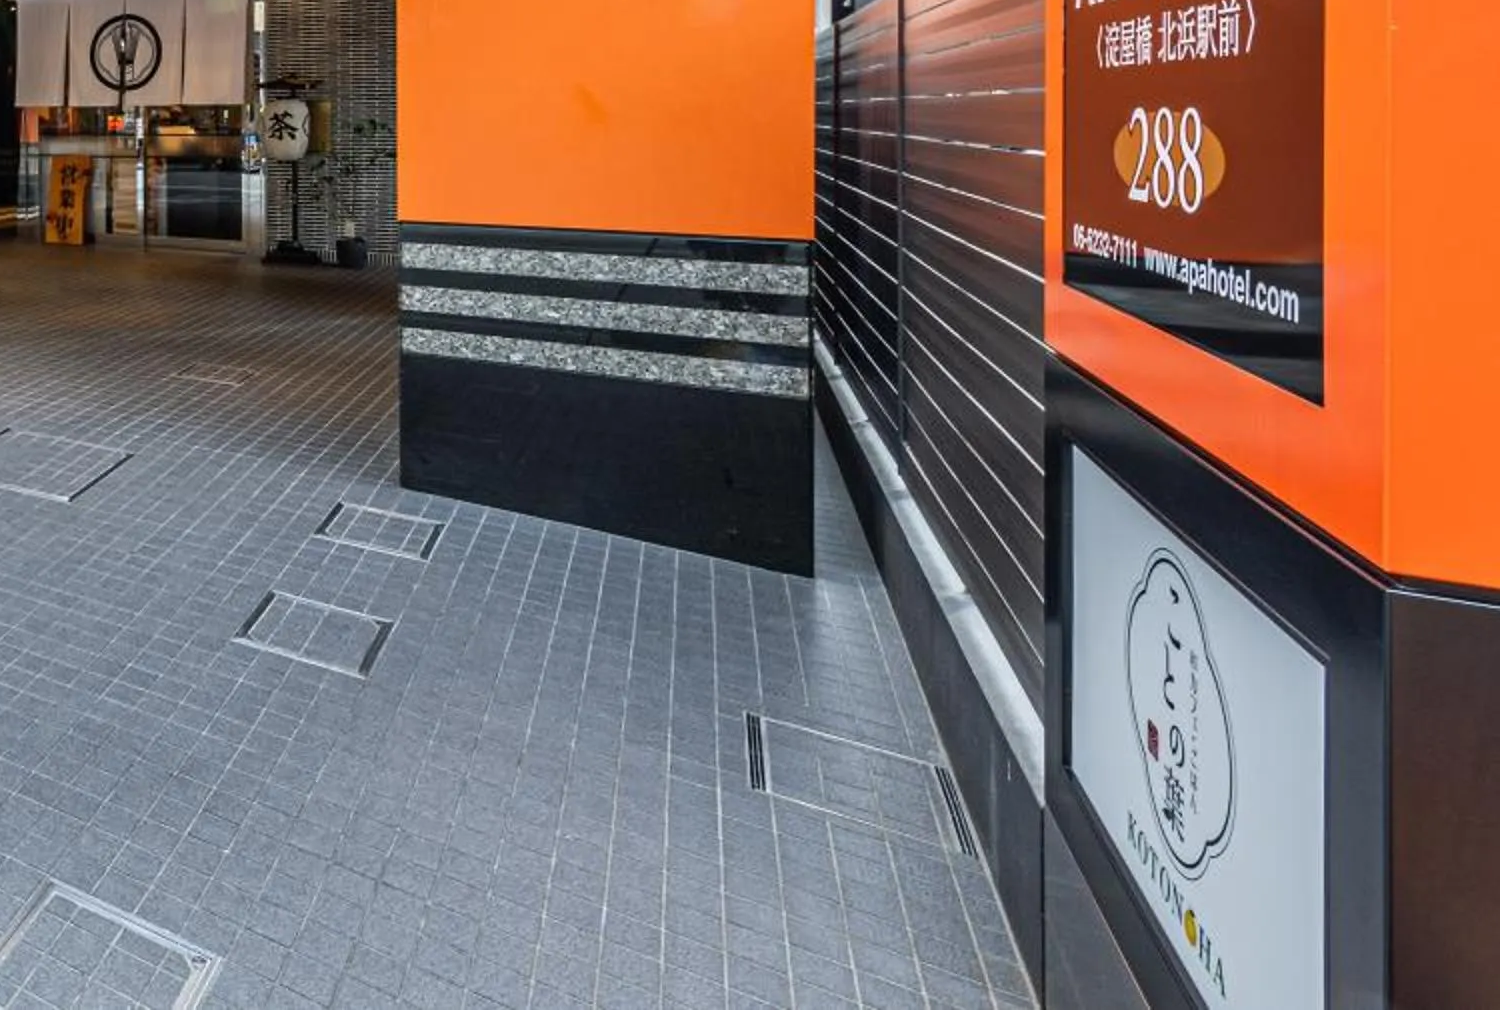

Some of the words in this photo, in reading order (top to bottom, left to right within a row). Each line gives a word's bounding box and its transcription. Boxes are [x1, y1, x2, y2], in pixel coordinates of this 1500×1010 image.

[267, 110, 298, 141] 茶
[1127, 106, 1203, 214] 288
[1072, 223, 1138, 269] 06-6232-7111
[1144, 246, 1300, 324] www.apahotel.com
